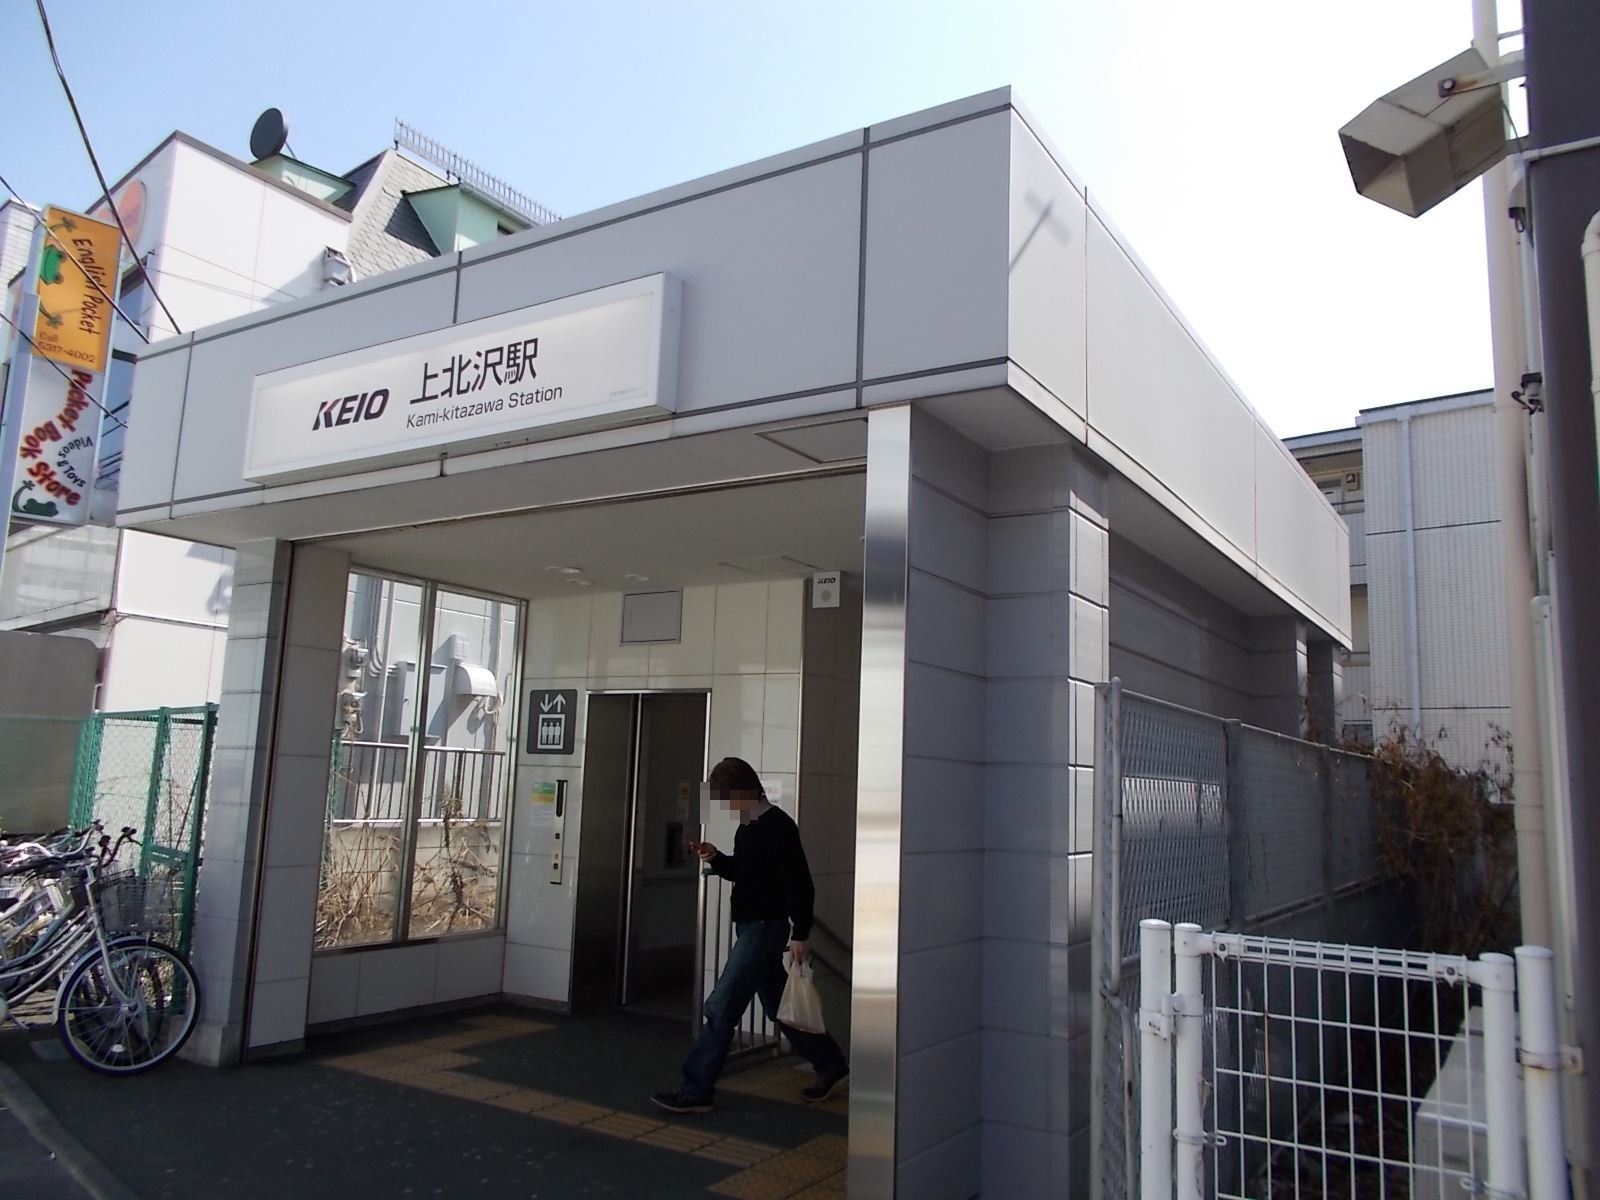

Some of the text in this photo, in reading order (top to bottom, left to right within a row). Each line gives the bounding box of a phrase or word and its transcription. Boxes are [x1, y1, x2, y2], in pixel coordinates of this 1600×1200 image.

[72, 238, 107, 335] English Pocket
[409, 337, 539, 405] 上北沢駅
[312, 388, 391, 431] KEIO
[406, 386, 563, 429] Kami-kitazawa Station
[19, 420, 63, 460] Book
[57, 434, 94, 459] Videos
[27, 461, 82, 507] Store
[63, 464, 87, 489] Toys
